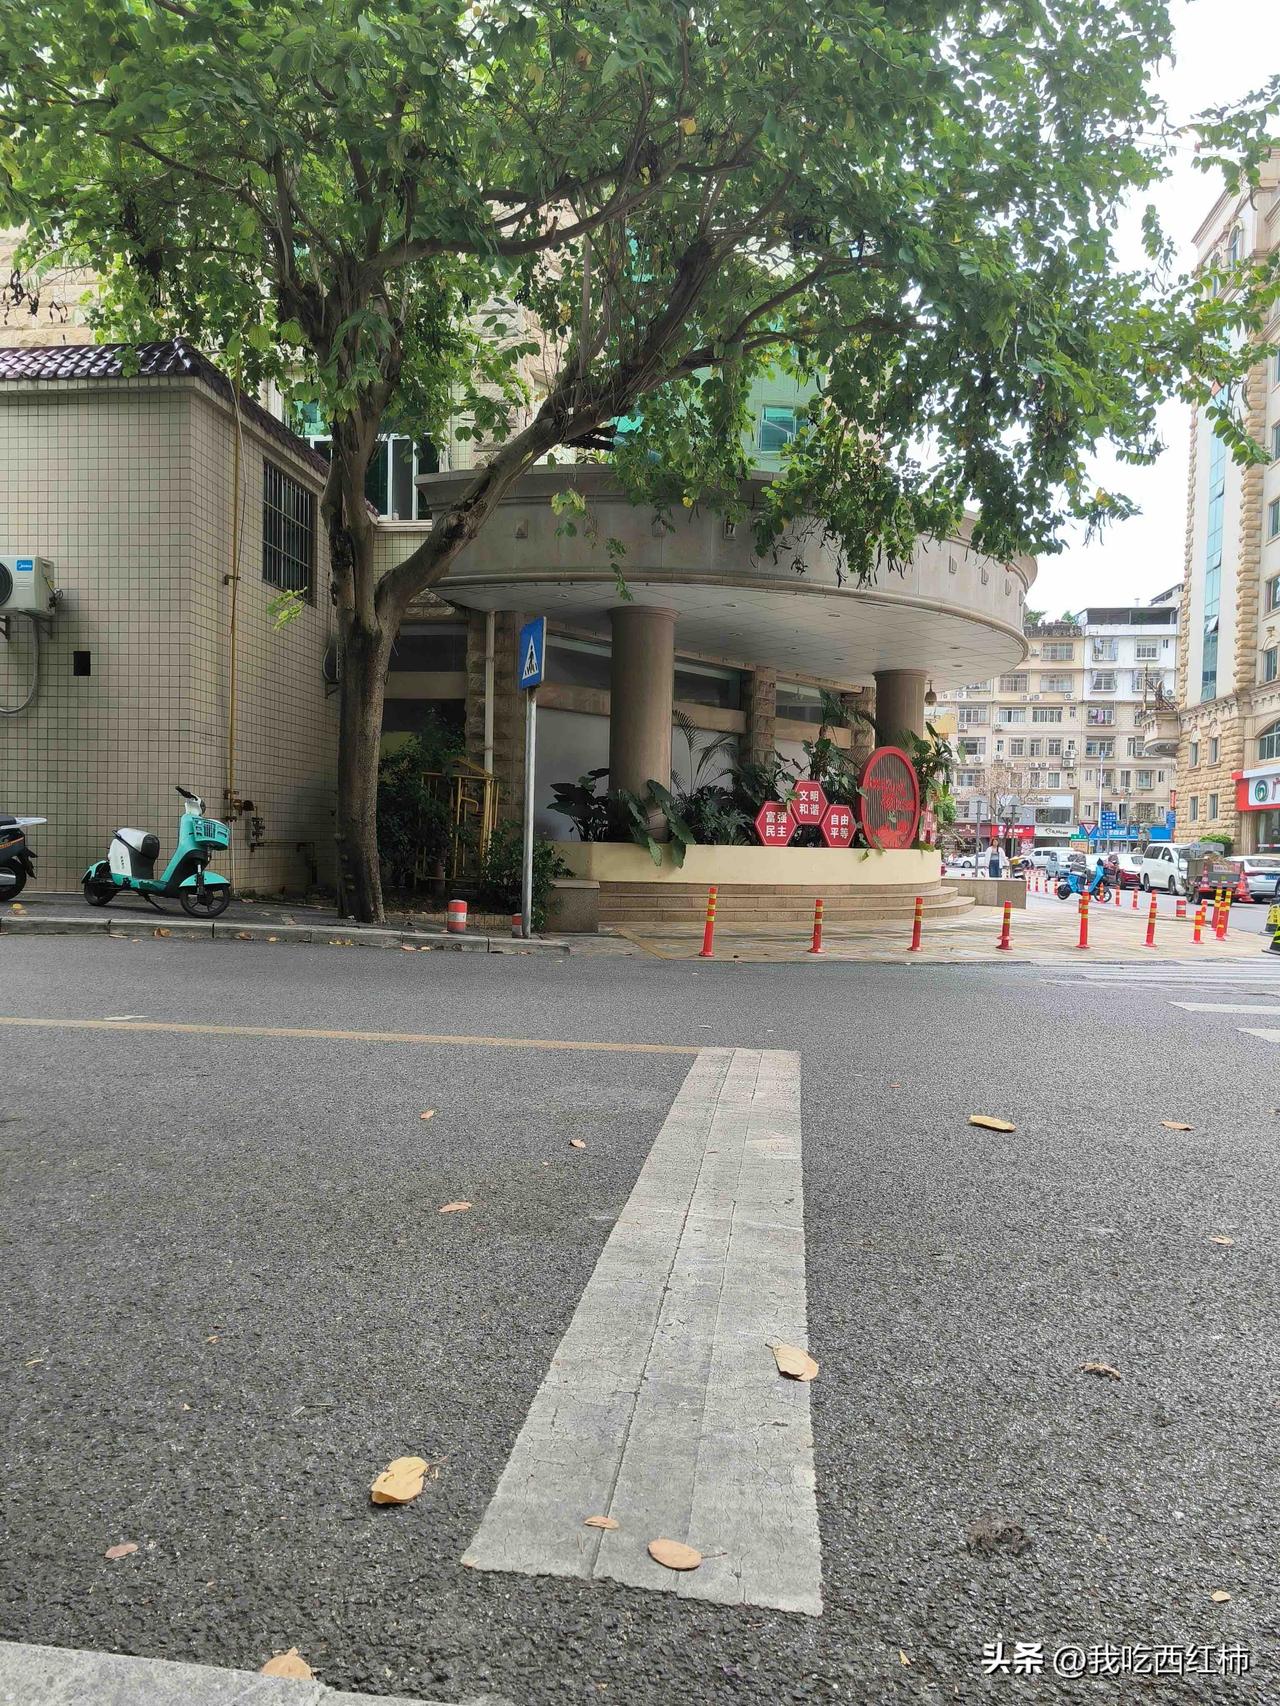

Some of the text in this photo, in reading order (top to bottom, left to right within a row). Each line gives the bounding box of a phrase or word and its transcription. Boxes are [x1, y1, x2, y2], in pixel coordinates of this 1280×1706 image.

[799, 790, 819, 802] 文明
[799, 803, 819, 815] 和谐
[766, 811, 787, 823] 富强
[831, 814, 849, 825] 自由
[766, 825, 787, 837] 民主
[830, 827, 849, 839] 平等
